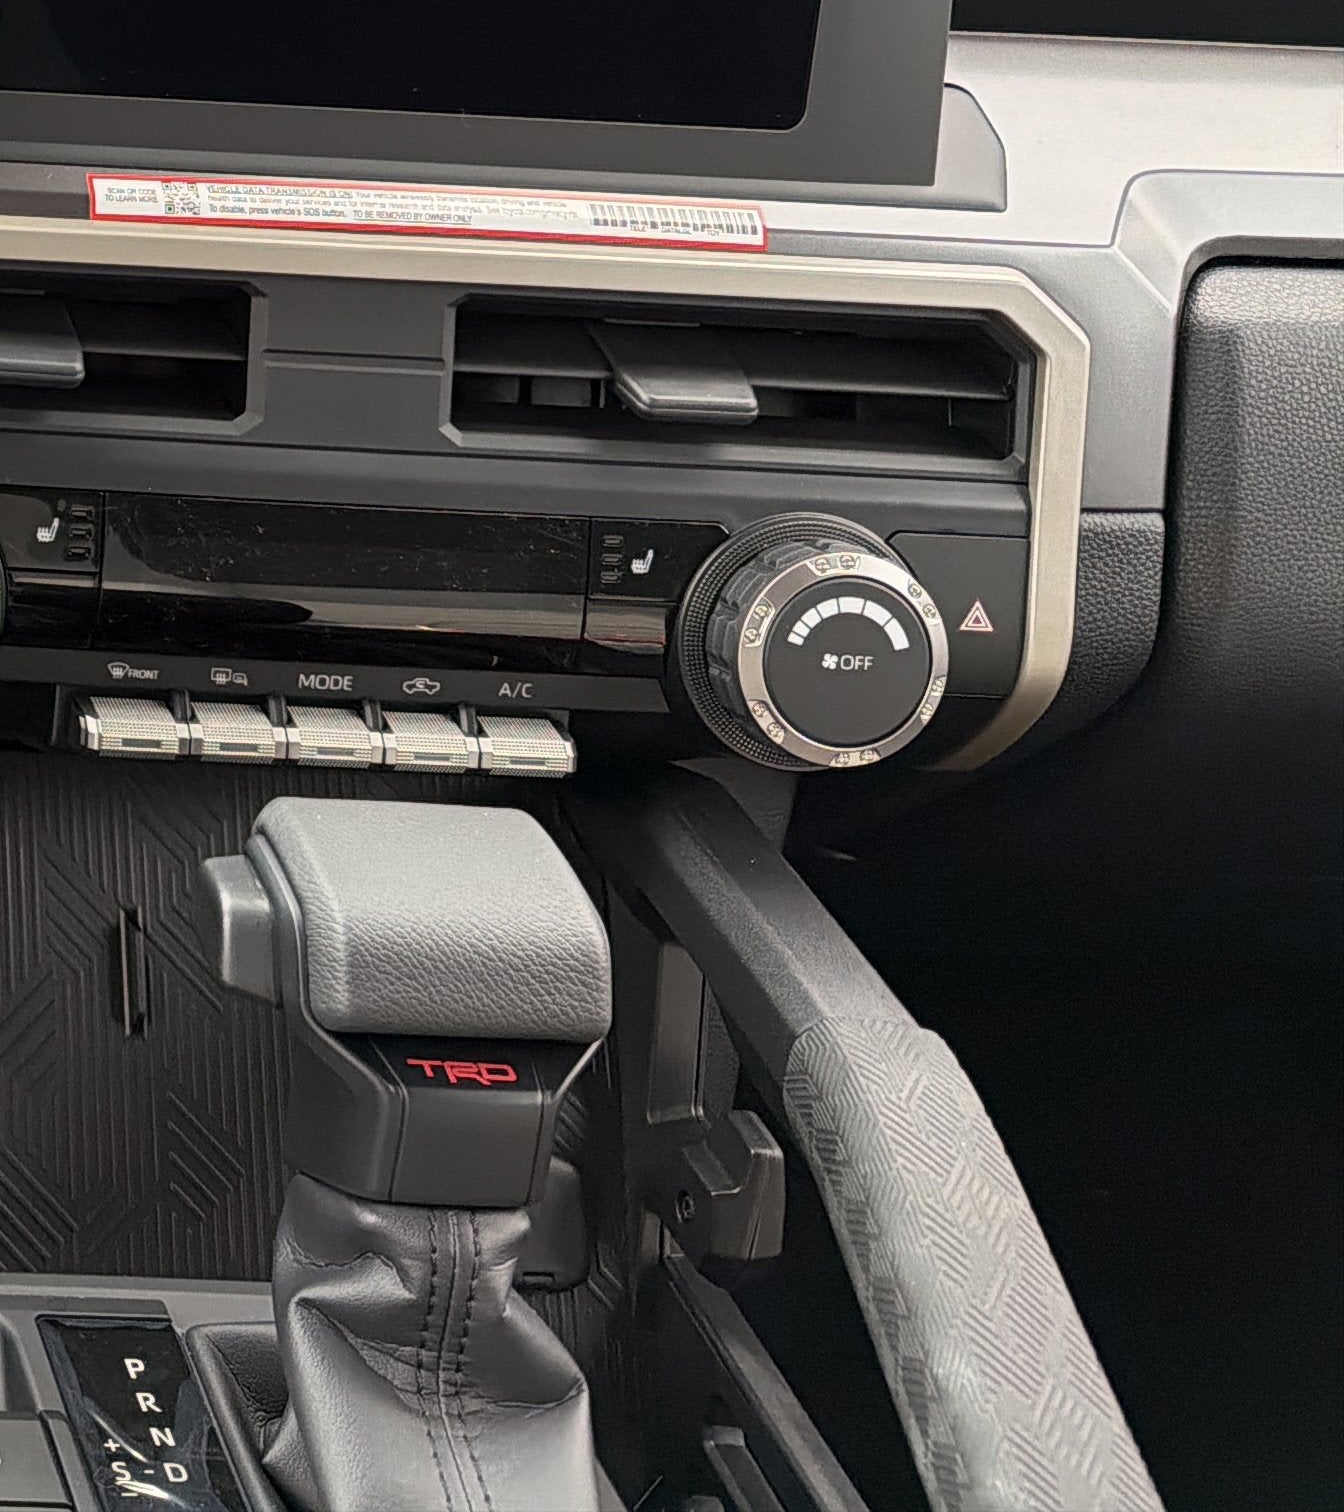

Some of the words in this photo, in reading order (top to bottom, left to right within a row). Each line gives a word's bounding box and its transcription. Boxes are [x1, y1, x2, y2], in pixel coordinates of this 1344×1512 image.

[105, 193, 114, 202] TO
[207, 184, 241, 193] VEHICLE
[209, 204, 218, 212] To
[249, 207, 269, 216] press
[303, 208, 320, 217] SOS
[353, 210, 364, 218] TO
[364, 210, 374, 219] BE
[376, 211, 412, 220] REMOVED
[414, 212, 423, 221] BY
[424, 213, 452, 222] OWNER
[453, 214, 472, 223] ONLY
[840, 656, 874, 670] OFF
[127, 669, 159, 680] FRONT
[298, 674, 353, 691] MODE
[498, 682, 533, 698] A/C
[406, 1058, 518, 1086] TRD
[123, 1358, 146, 1380] P
[135, 1392, 162, 1414] R
[149, 1427, 175, 1448] N
[112, 1462, 131, 1481] S
[163, 1462, 188, 1484] D
